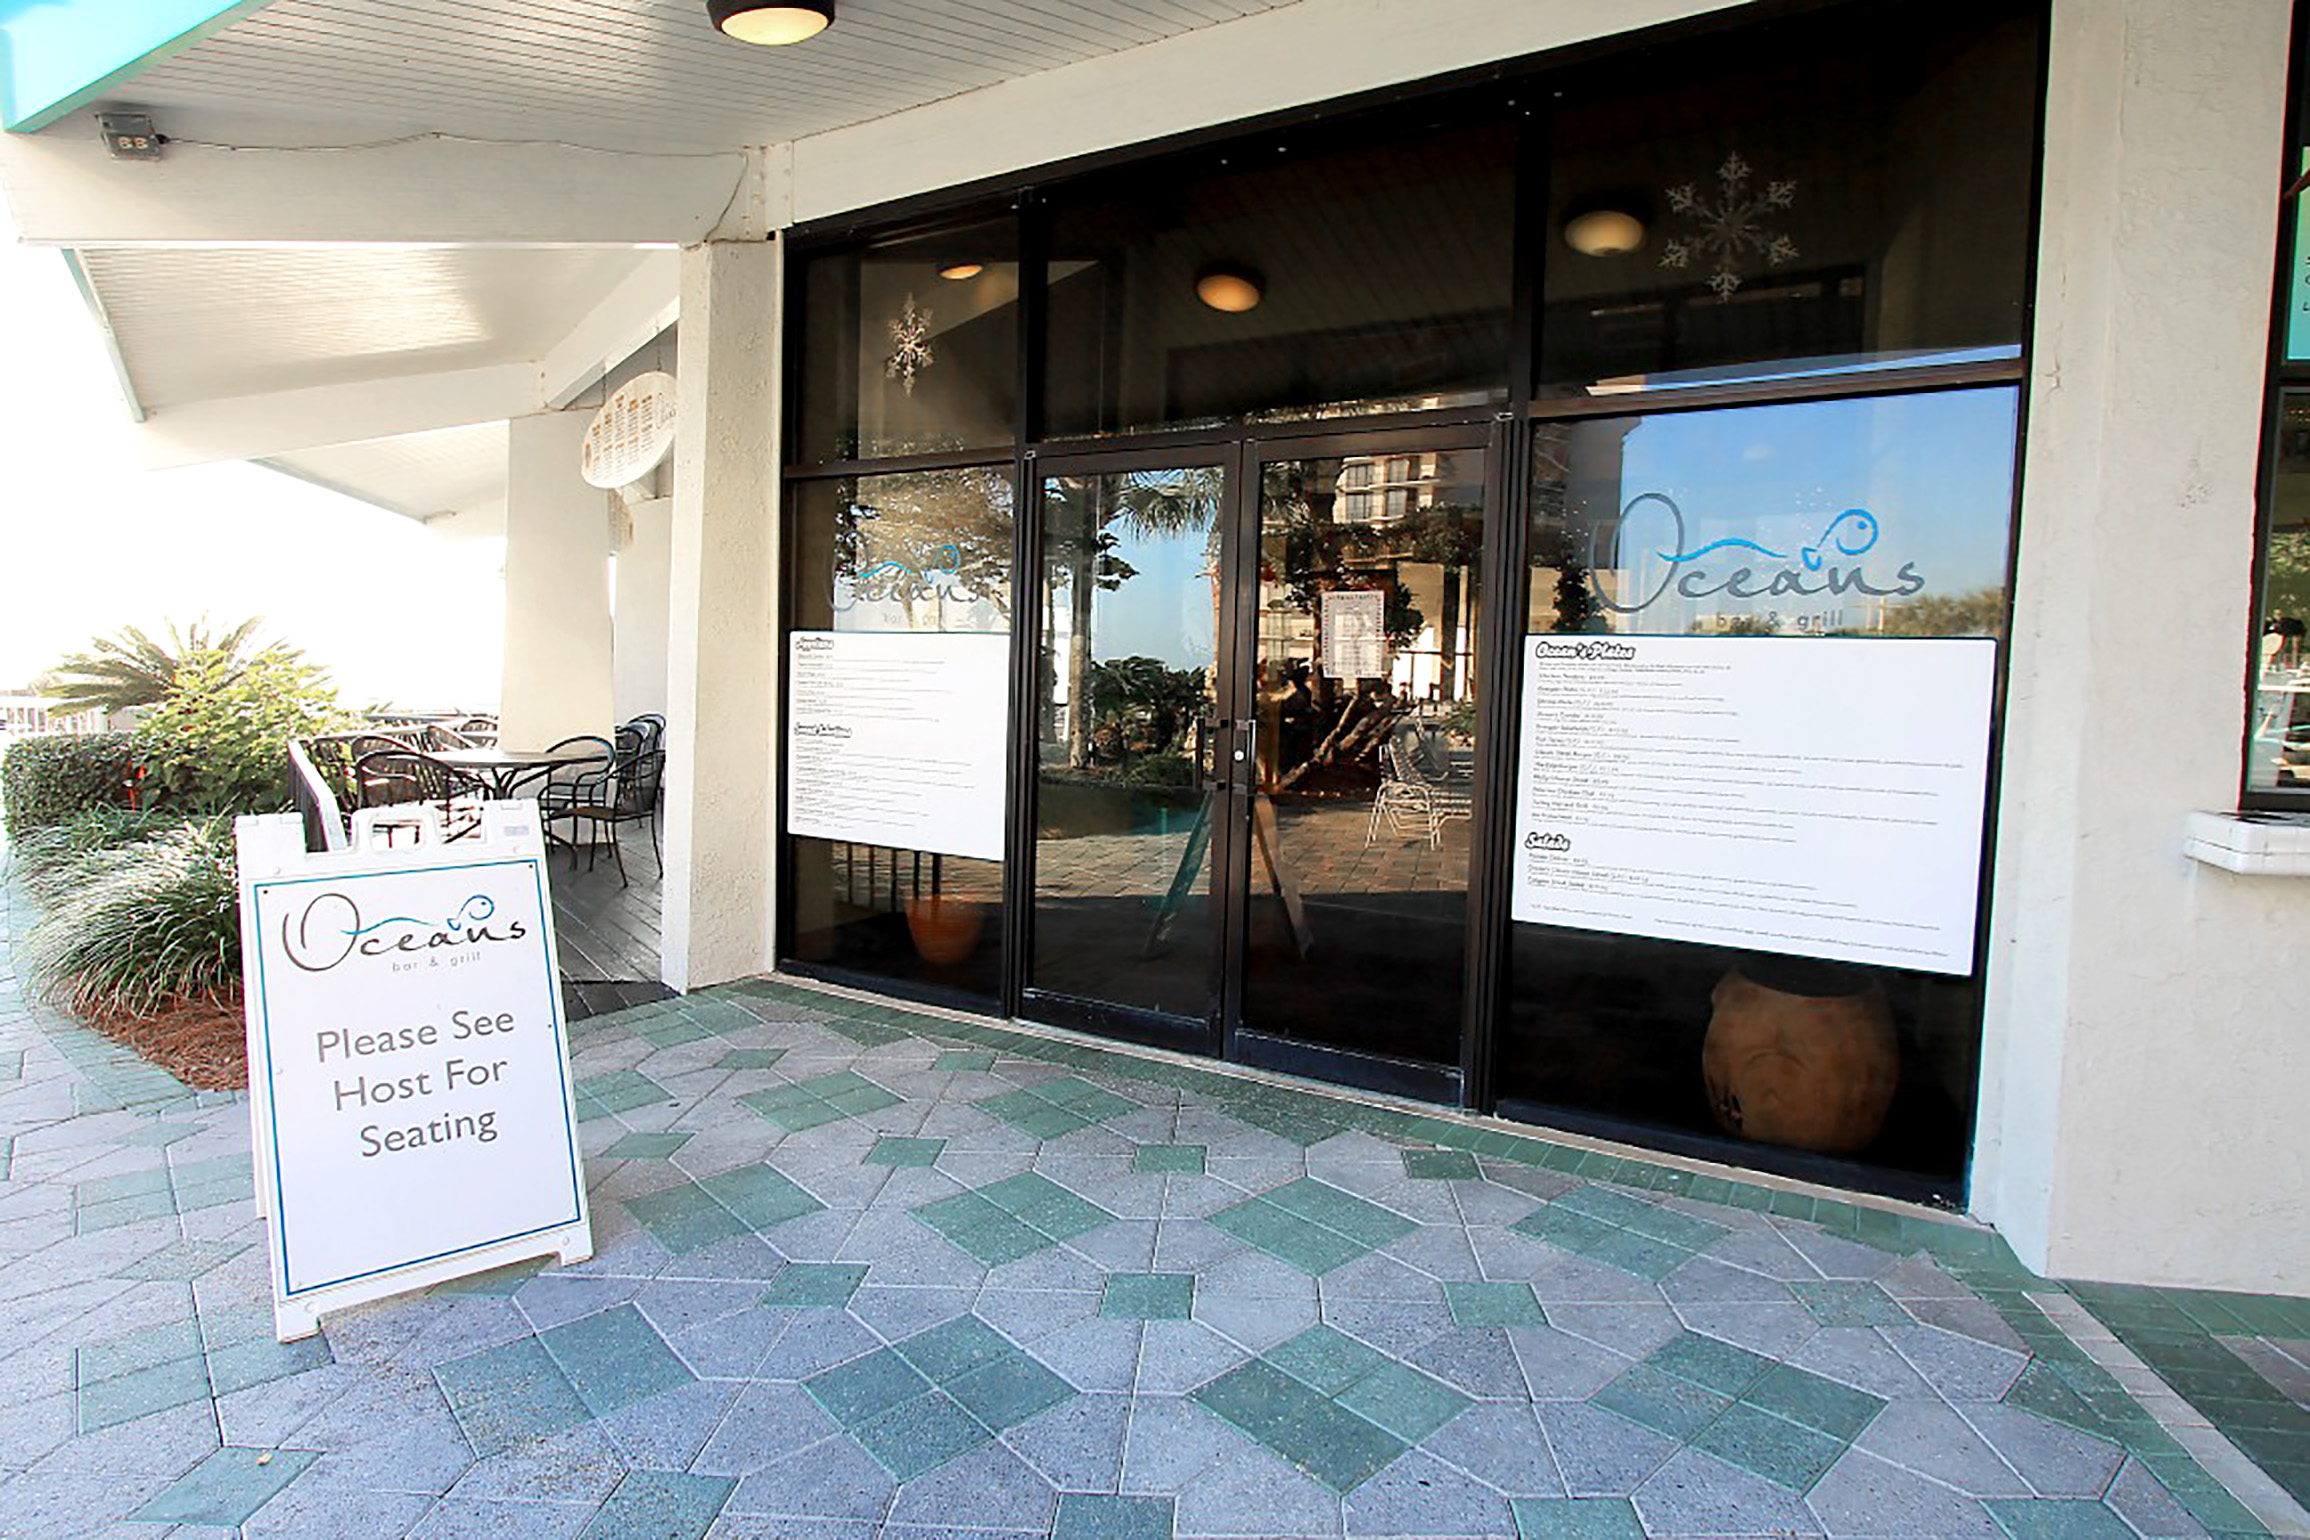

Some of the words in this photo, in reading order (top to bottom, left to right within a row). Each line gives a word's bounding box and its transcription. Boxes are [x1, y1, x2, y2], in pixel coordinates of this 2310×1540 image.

[1587, 492, 1926, 614] Oceans
[1767, 611, 1782, 629] &
[1796, 609, 1844, 631] grill
[1588, 641, 1637, 661] Plates
[282, 892, 527, 972] Oceans
[392, 961, 419, 973] bar
[429, 957, 439, 968] &
[449, 951, 482, 968] grill
[316, 1025, 438, 1064] Please
[451, 1010, 516, 1040] See
[333, 1073, 433, 1112] Host
[445, 1059, 508, 1091] For
[360, 1111, 499, 1158] Seating
